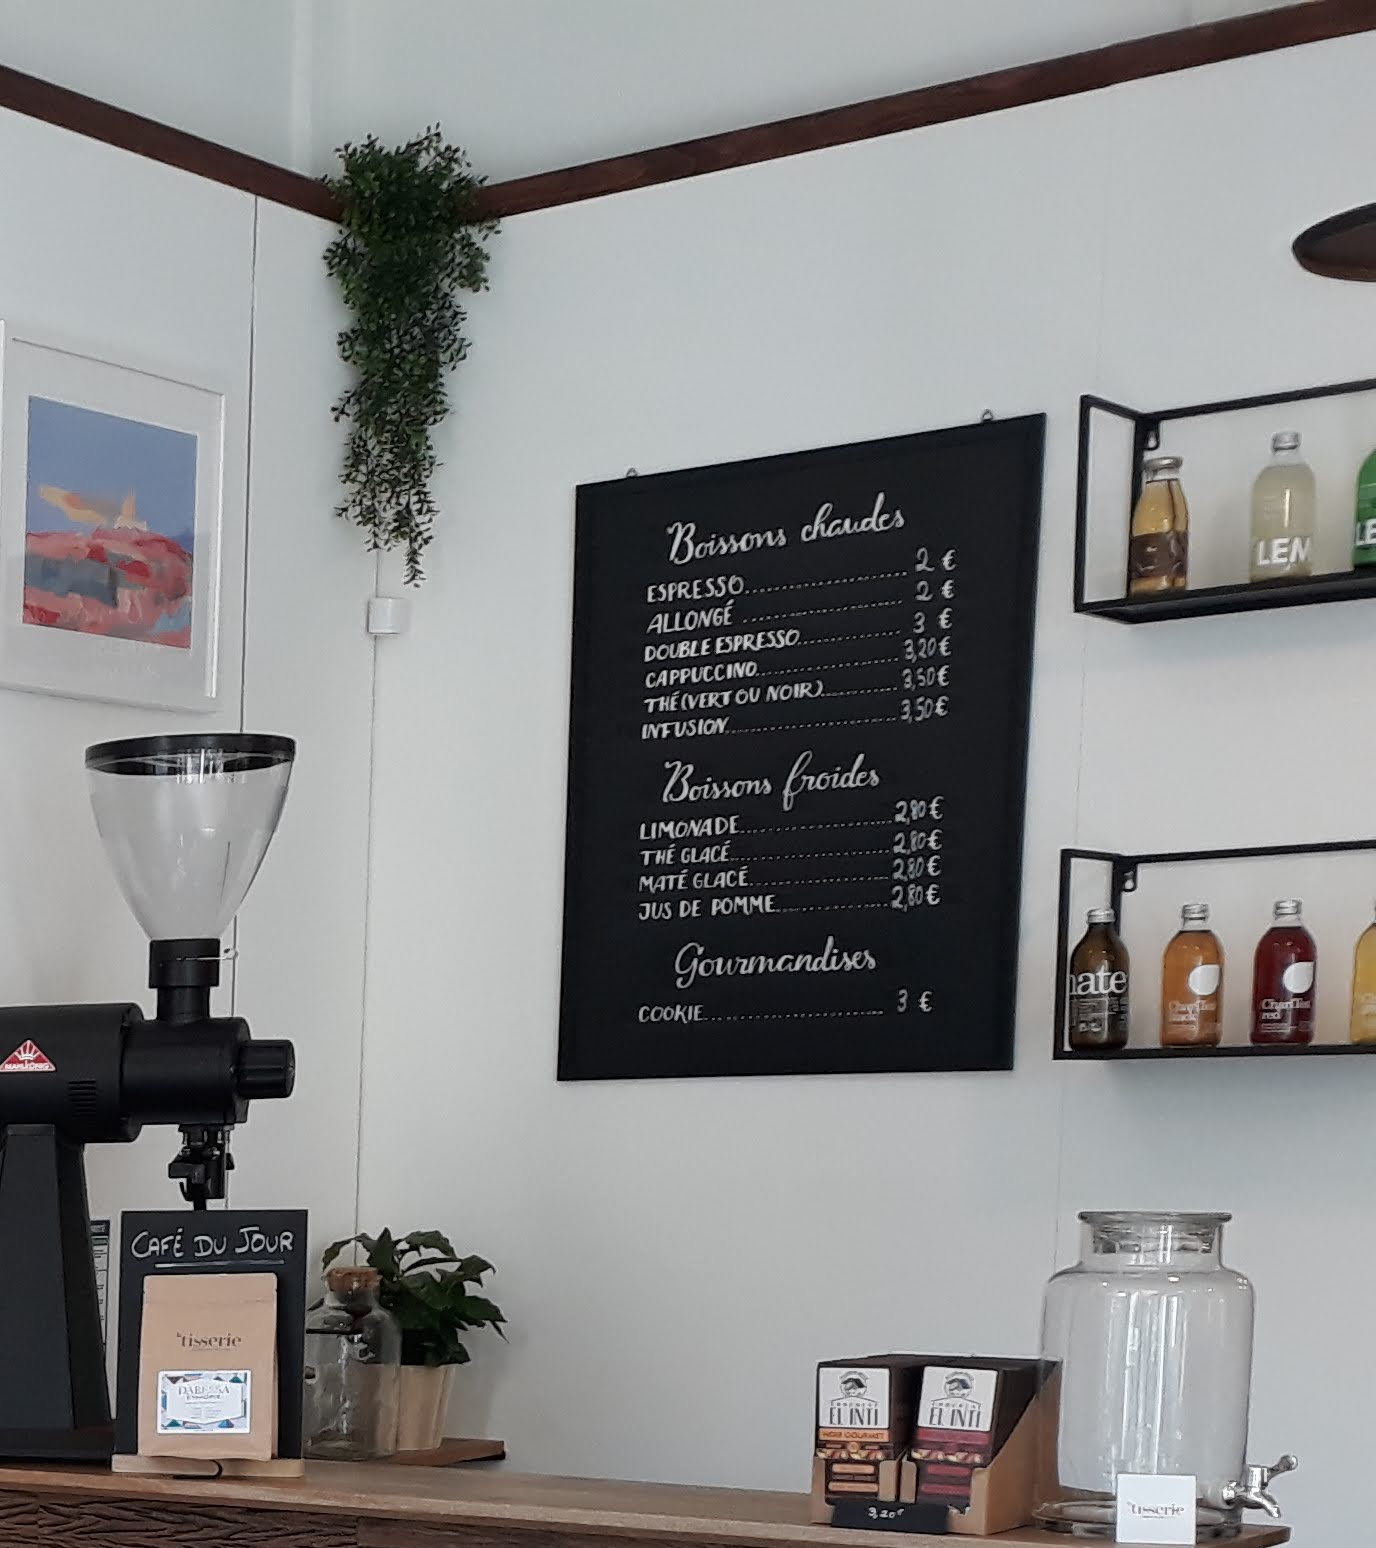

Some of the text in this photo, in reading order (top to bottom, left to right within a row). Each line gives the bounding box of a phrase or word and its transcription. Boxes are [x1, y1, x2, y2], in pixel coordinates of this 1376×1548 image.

[667, 492, 905, 565] Boissons chaudes
[647, 575, 745, 603] ESPRESSO
[914, 547, 935, 572] 2
[646, 599, 735, 634] ALLONGÉ
[915, 580, 934, 601] 2
[644, 637, 711, 662] DOUBLE
[715, 628, 801, 655] ESPRESSO
[912, 612, 926, 634] 3
[645, 661, 758, 689] CAPPUCCINO
[735, 686, 760, 705] OU
[766, 679, 824, 702] NOIR)
[641, 717, 730, 739] INFUSION
[662, 750, 880, 812] Boissons froides
[639, 815, 740, 841] LIMONADE
[640, 843, 675, 866] THÉ
[680, 840, 731, 865] GLACÉ
[638, 869, 689, 895] MATÉ
[692, 865, 749, 889] GLACÉ
[638, 902, 672, 921] JUS
[679, 900, 701, 918] DE
[711, 895, 776, 916] POMME
[674, 936, 877, 989] Gourmandises
[638, 1005, 705, 1023] COOKIE
[897, 989, 908, 1013] 3
[131, 1226, 294, 1258] CAFÉ DU JOUR
